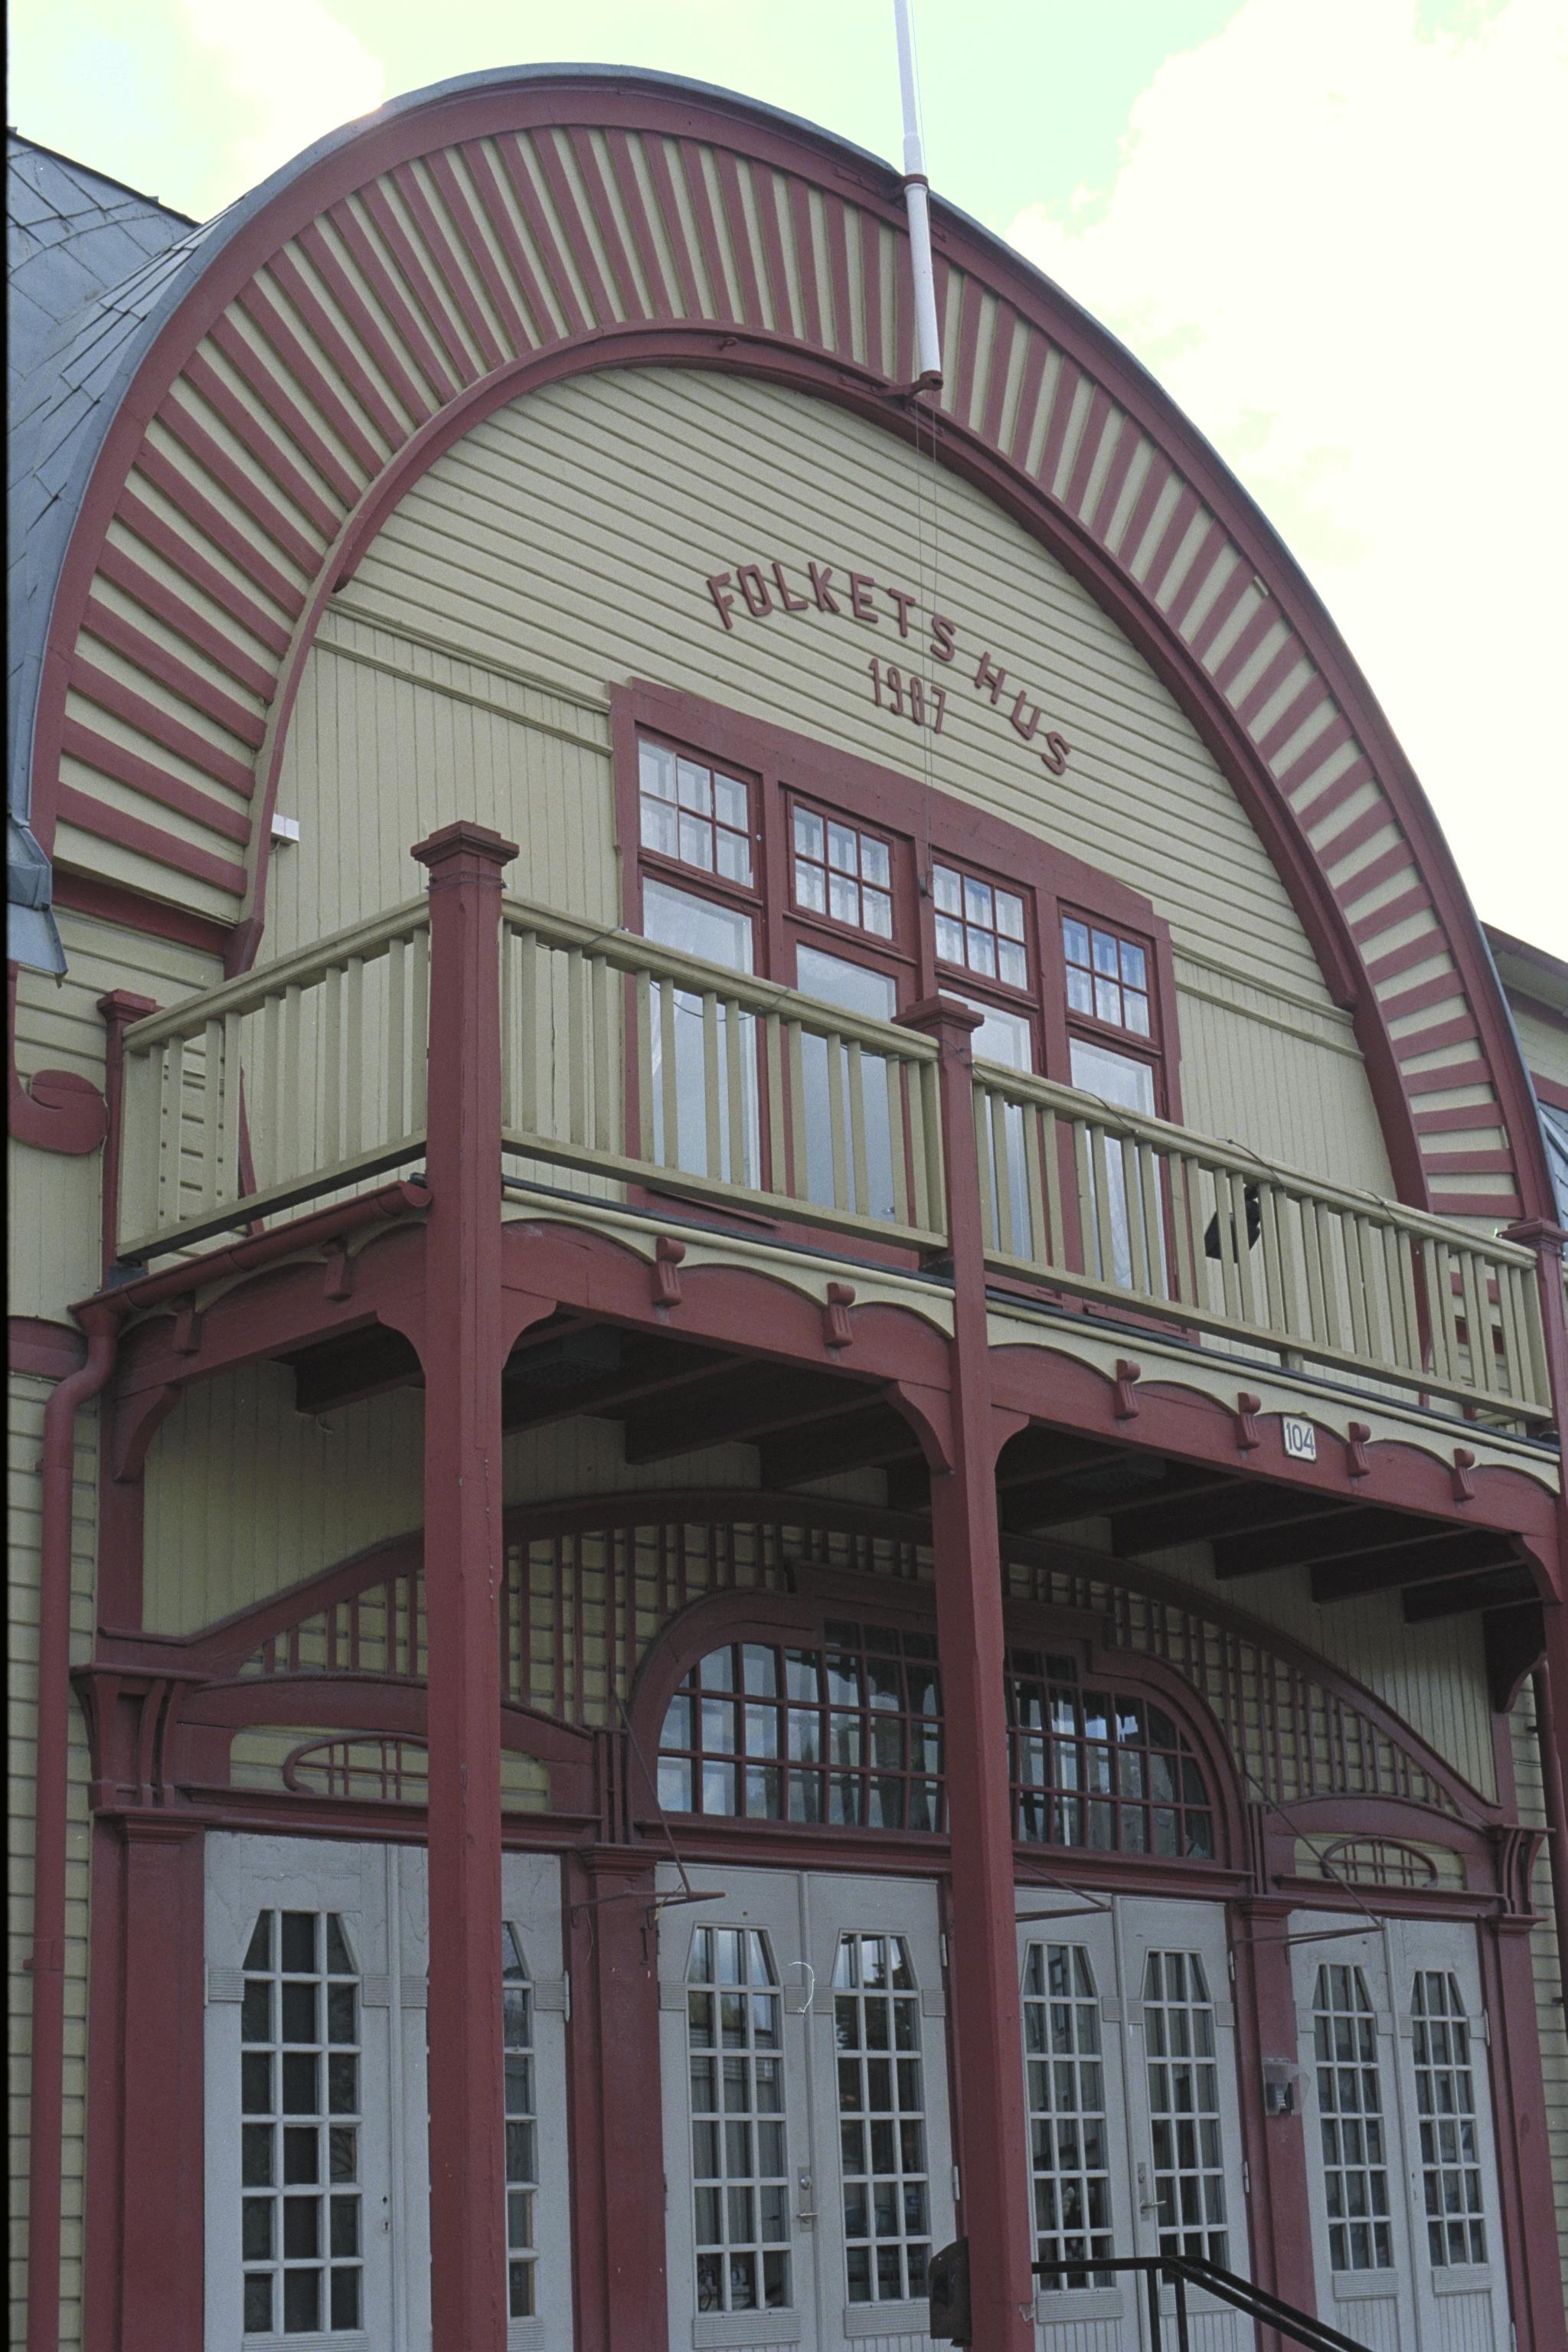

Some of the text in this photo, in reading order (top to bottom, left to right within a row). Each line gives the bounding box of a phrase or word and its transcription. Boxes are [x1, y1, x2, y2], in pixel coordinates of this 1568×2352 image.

[707, 561, 1071, 776] FOLKETS HUS
[868, 658, 946, 734] 1907
[1286, 1422, 1315, 1456] 104
